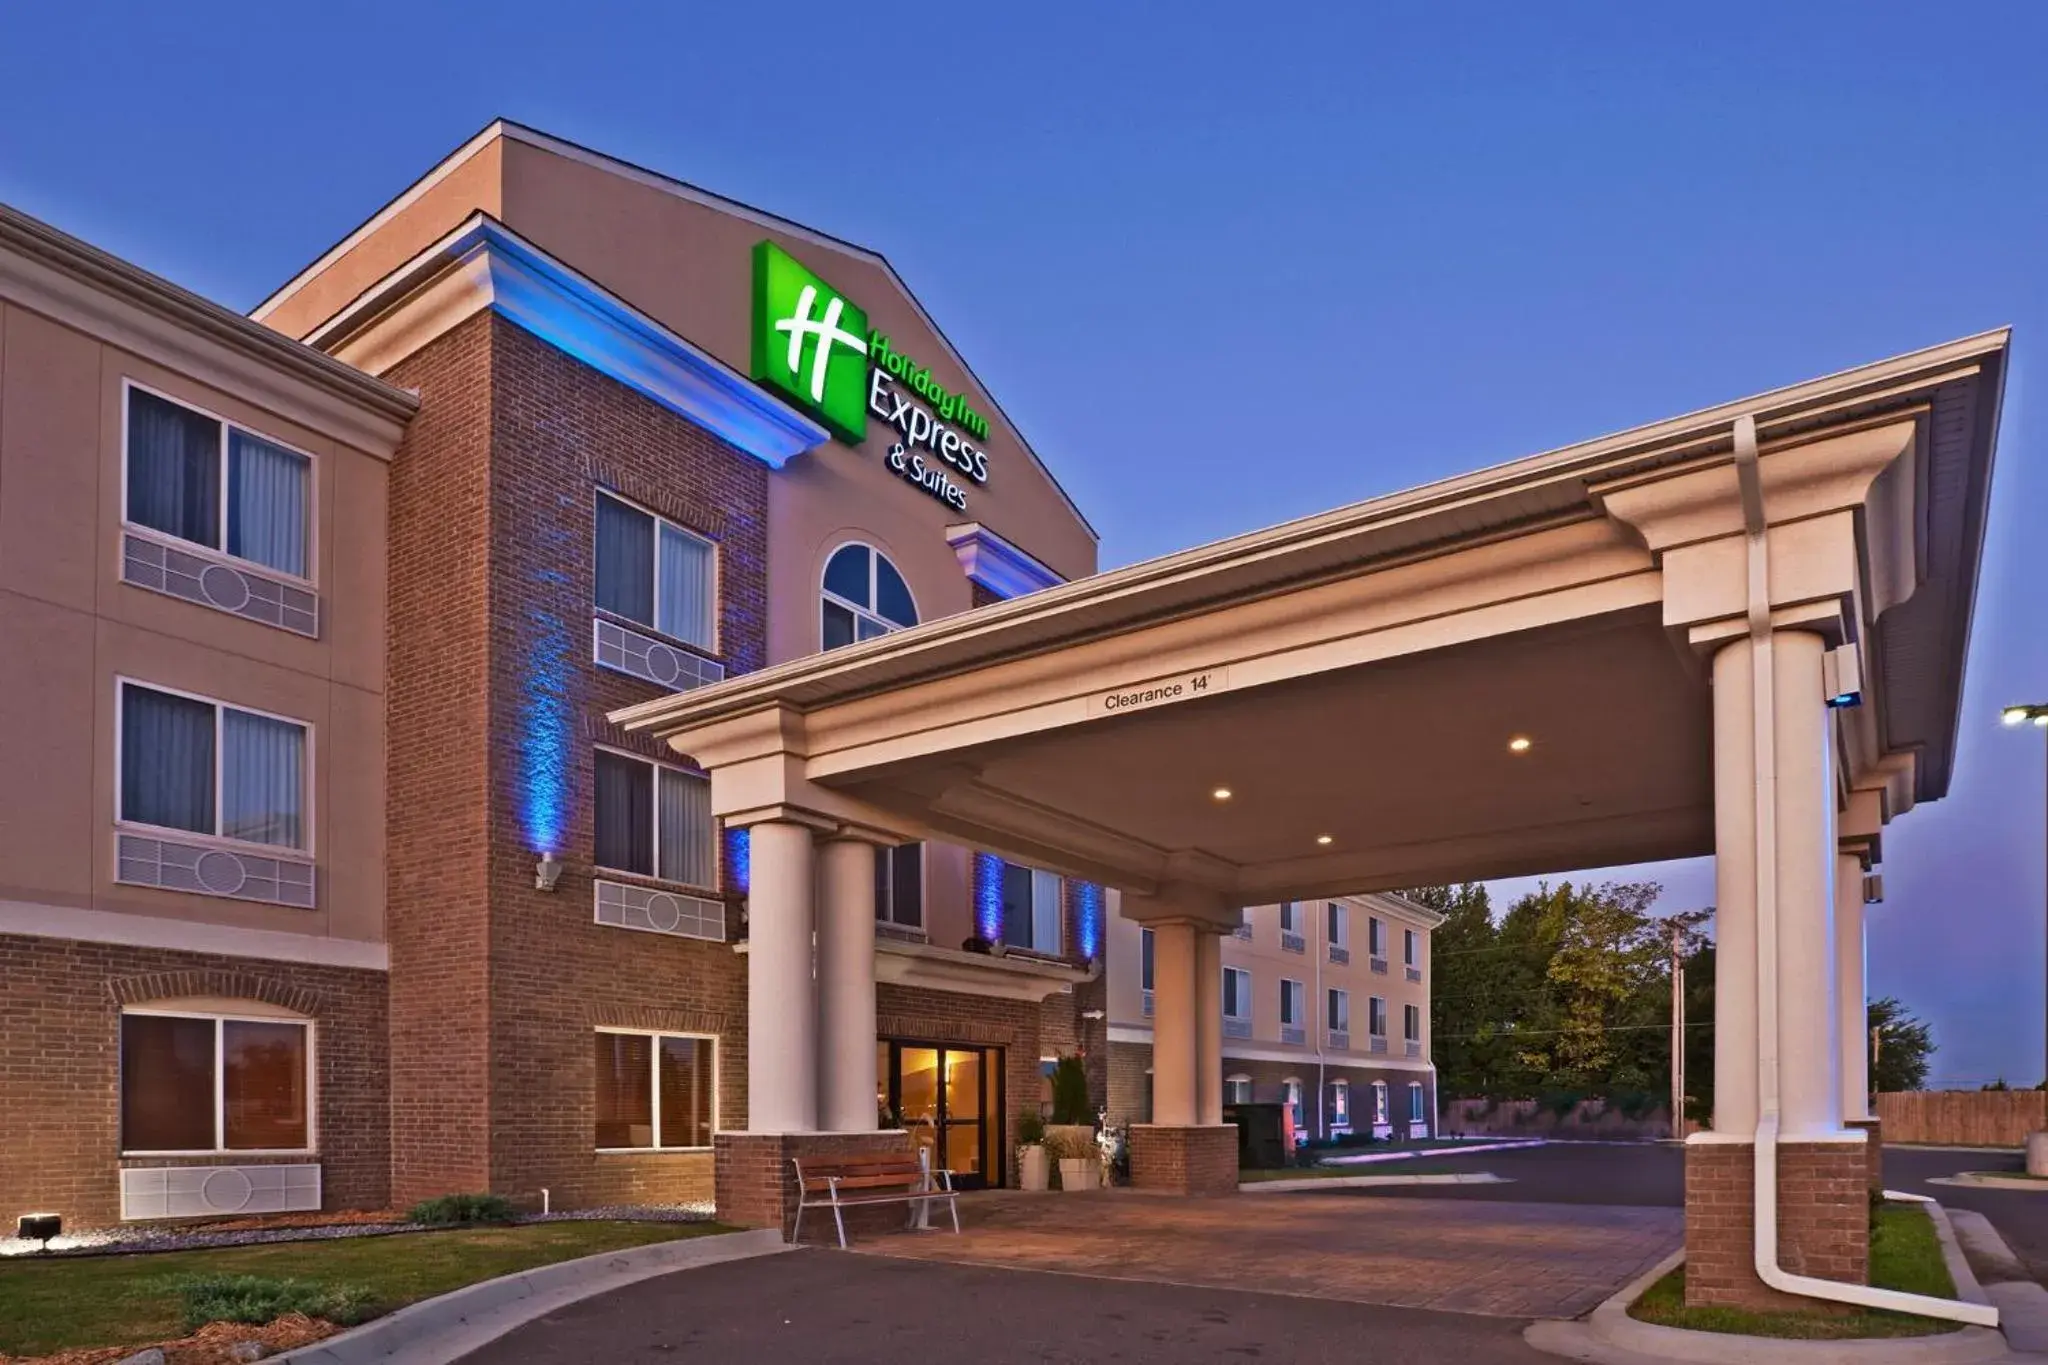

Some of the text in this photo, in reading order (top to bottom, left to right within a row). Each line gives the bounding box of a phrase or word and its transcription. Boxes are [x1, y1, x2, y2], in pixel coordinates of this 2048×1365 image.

[869, 331, 989, 439] Holiday Inn
[870, 367, 988, 483] Express
[890, 443, 967, 511] & Suites
[1105, 684, 1183, 709] Clearance
